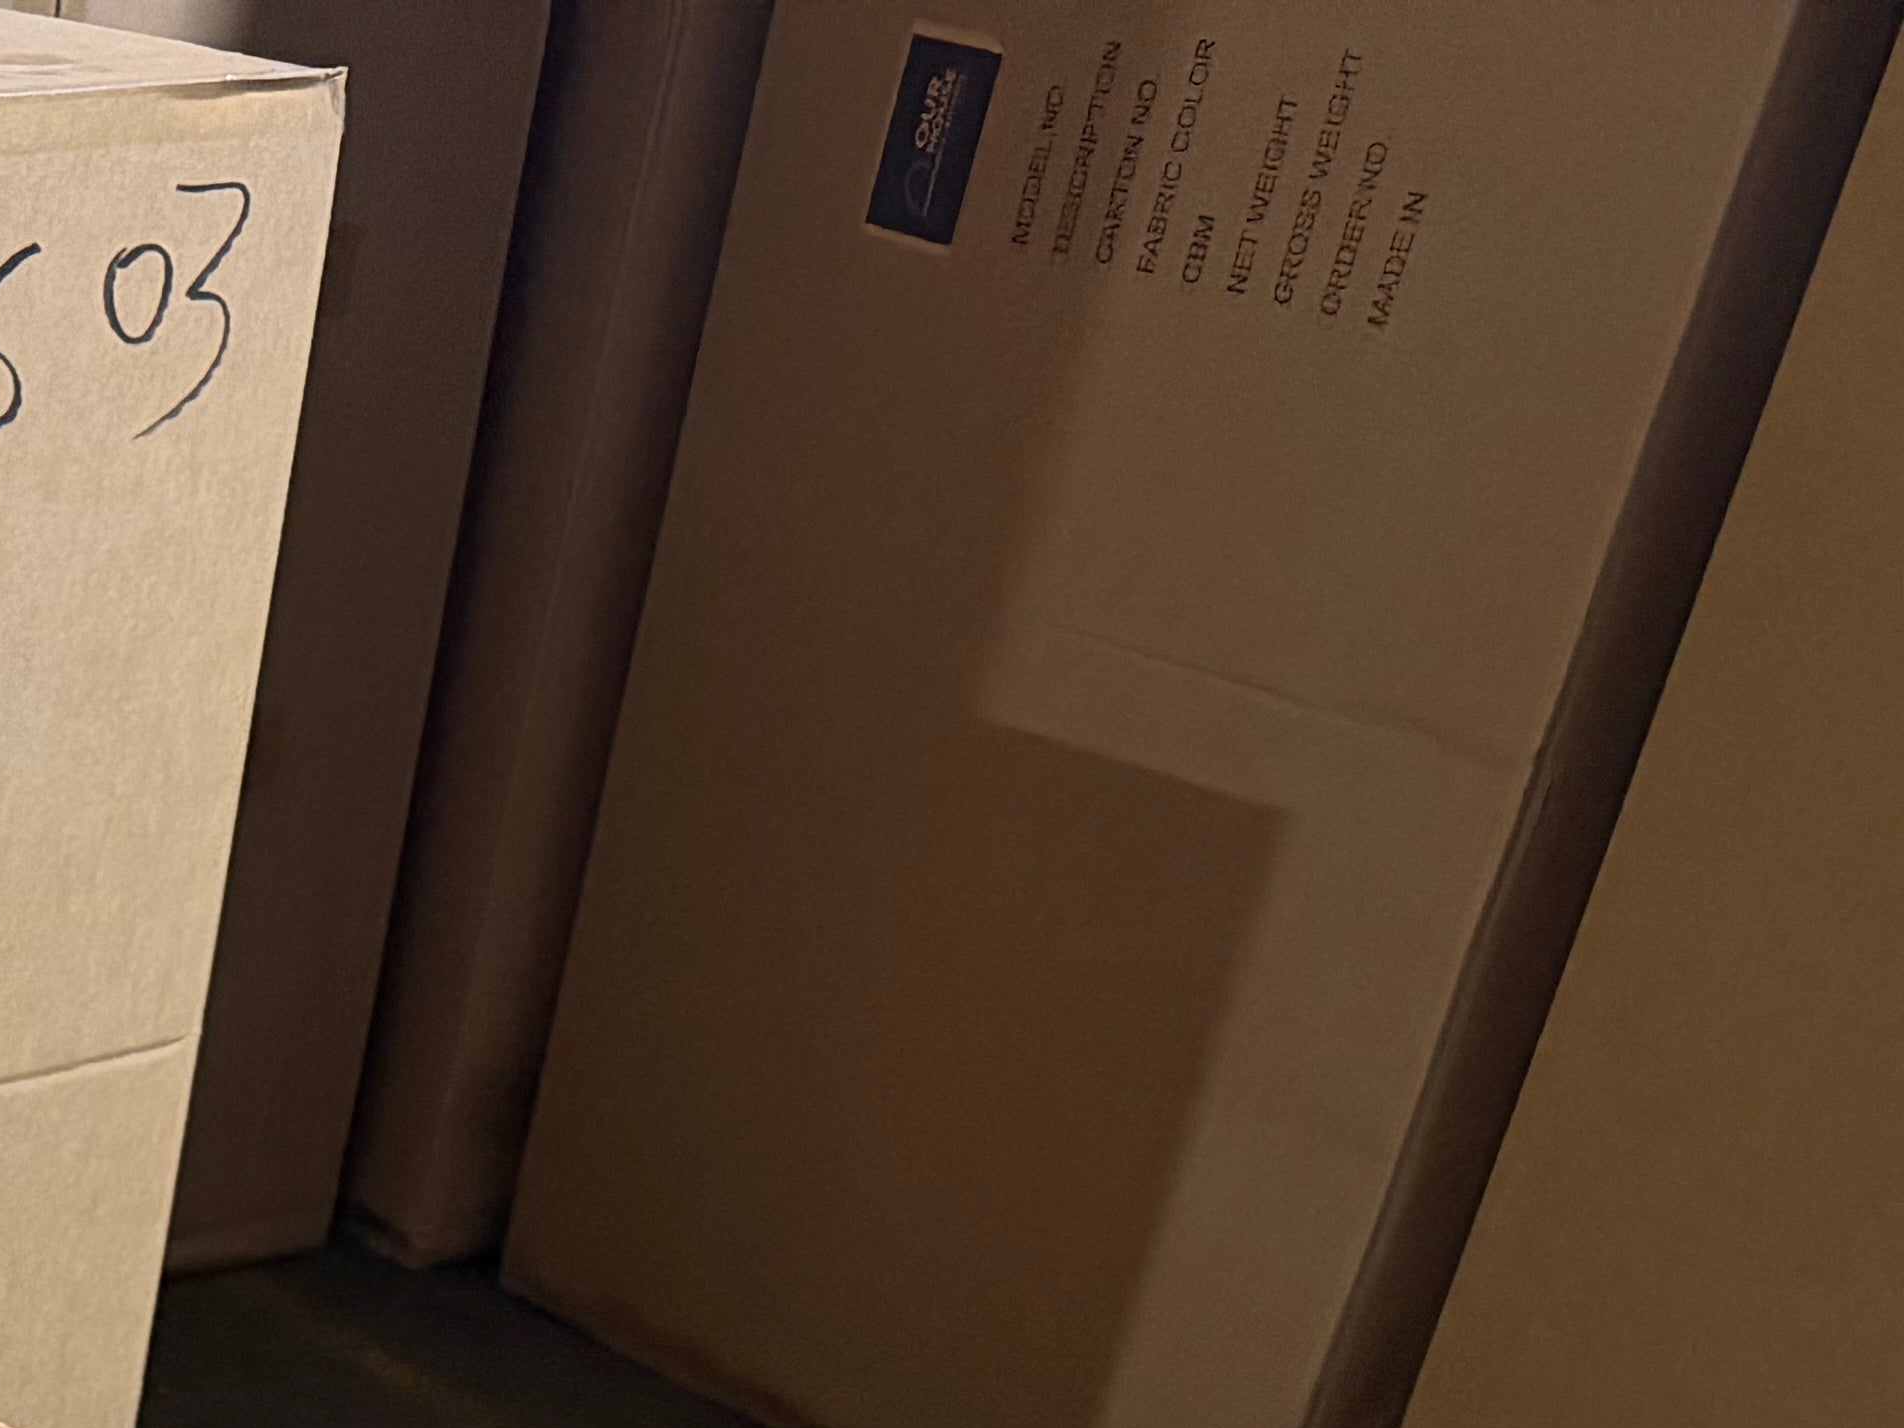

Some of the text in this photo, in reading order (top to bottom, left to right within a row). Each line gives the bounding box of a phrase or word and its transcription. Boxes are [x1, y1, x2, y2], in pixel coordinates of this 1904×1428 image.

[915, 75, 942, 150] OUR
[1052, 40, 1121, 254] DESCRIPTION
[1137, 39, 1215, 273] FABRIC COLOR
[1227, 94, 1297, 294] NET WEIGHT
[1274, 48, 1361, 304] GROSS WEIGHT
[1096, 135, 1144, 264] CARTON
[1182, 214, 1215, 283] CBM
[1320, 199, 1372, 316] ORDER
[1367, 191, 1428, 326] MADE IN
[103, 182, 250, 439] 03
